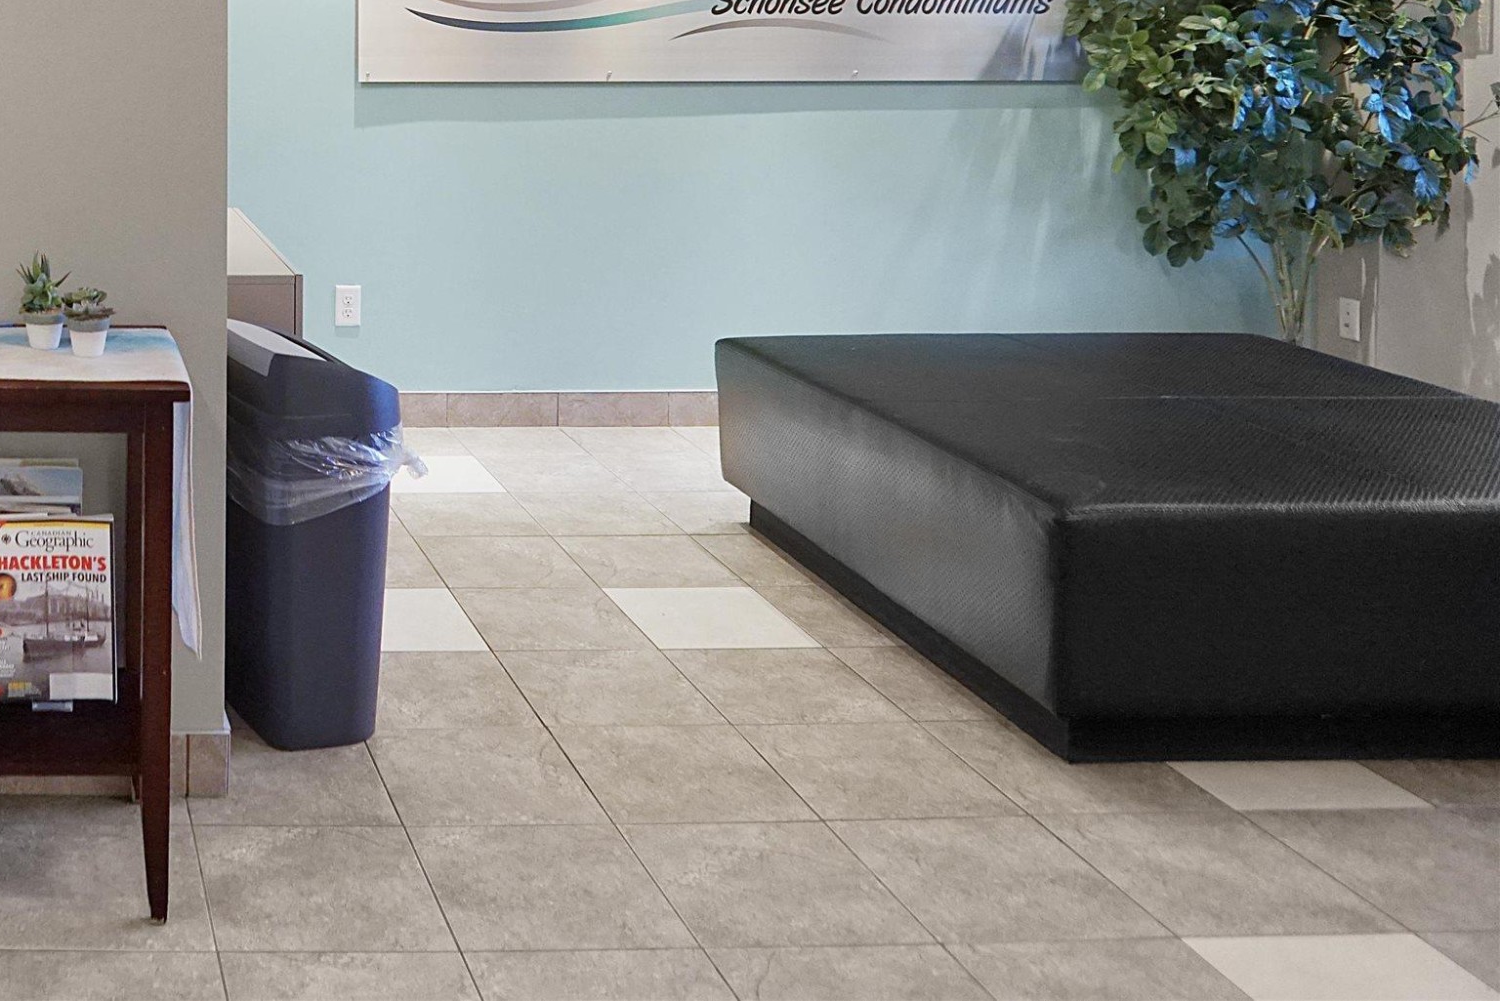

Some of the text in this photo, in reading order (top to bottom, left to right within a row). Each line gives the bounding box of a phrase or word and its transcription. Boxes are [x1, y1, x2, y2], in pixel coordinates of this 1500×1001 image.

[15, 530, 94, 553] Geographic
[21, 572, 107, 583] LAST SHIP FOUND
